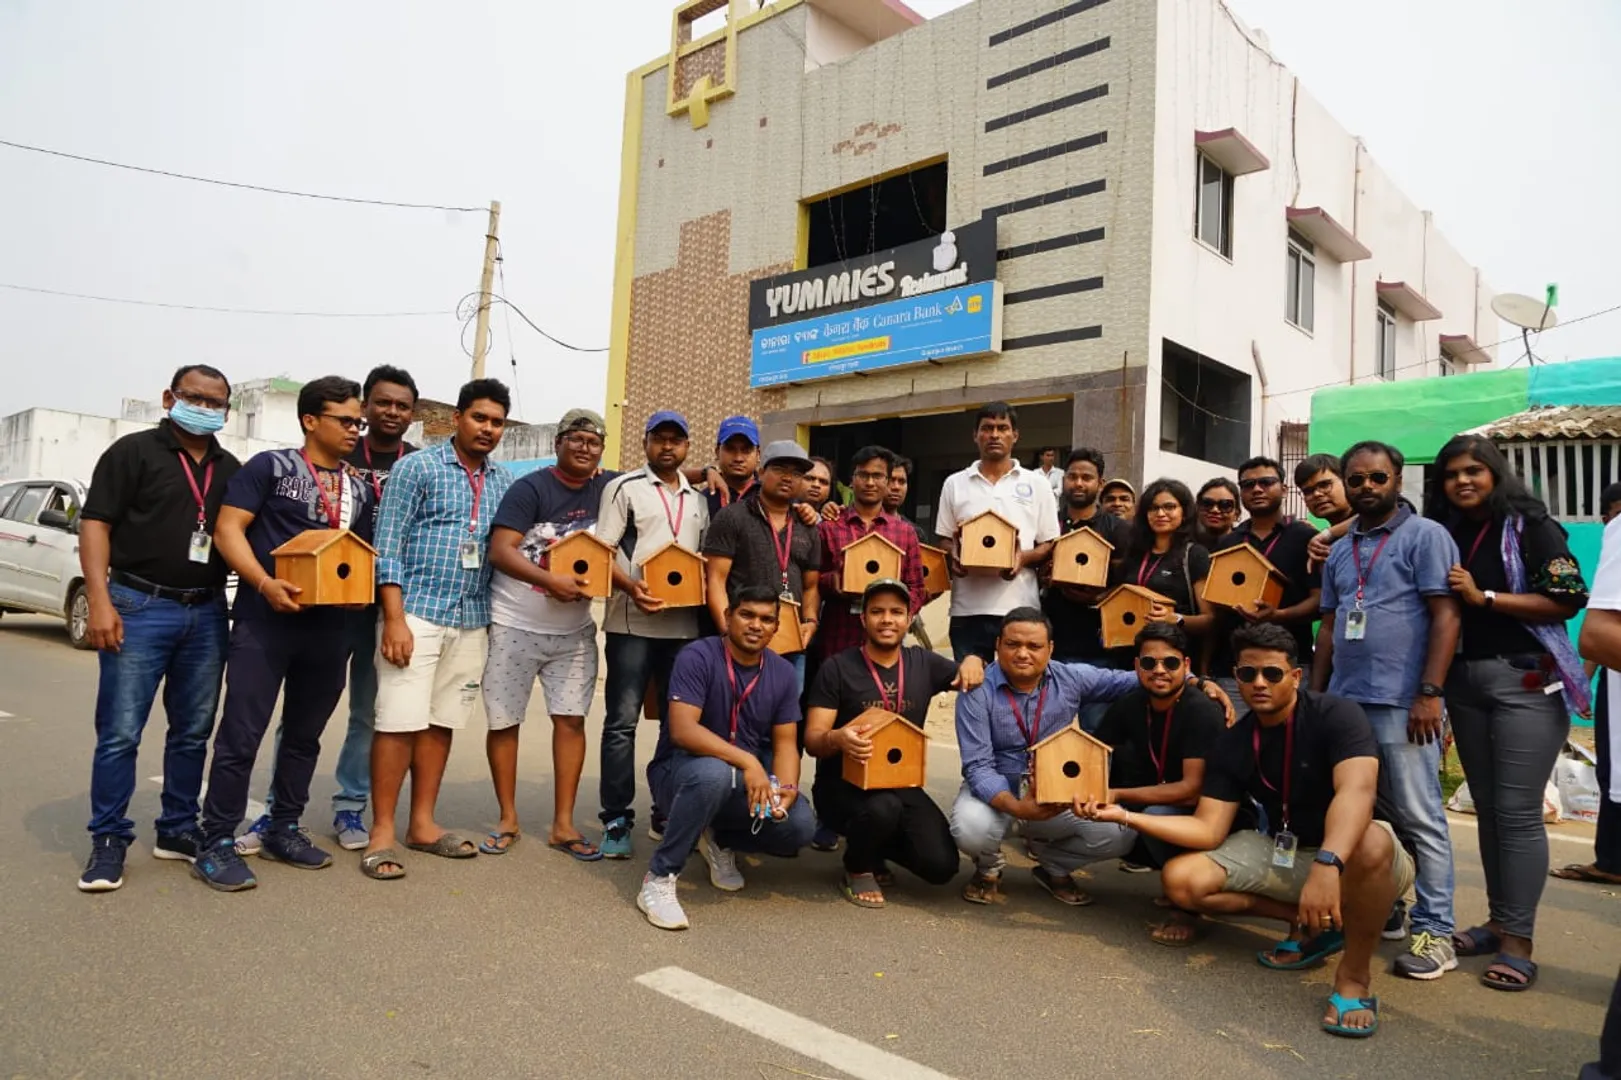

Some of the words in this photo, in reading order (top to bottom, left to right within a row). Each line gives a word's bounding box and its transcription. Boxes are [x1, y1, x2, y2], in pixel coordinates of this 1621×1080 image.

[766, 260, 896, 318] YUMMIES
[873, 308, 911, 329] Canara
[914, 302, 943, 321] Bank
